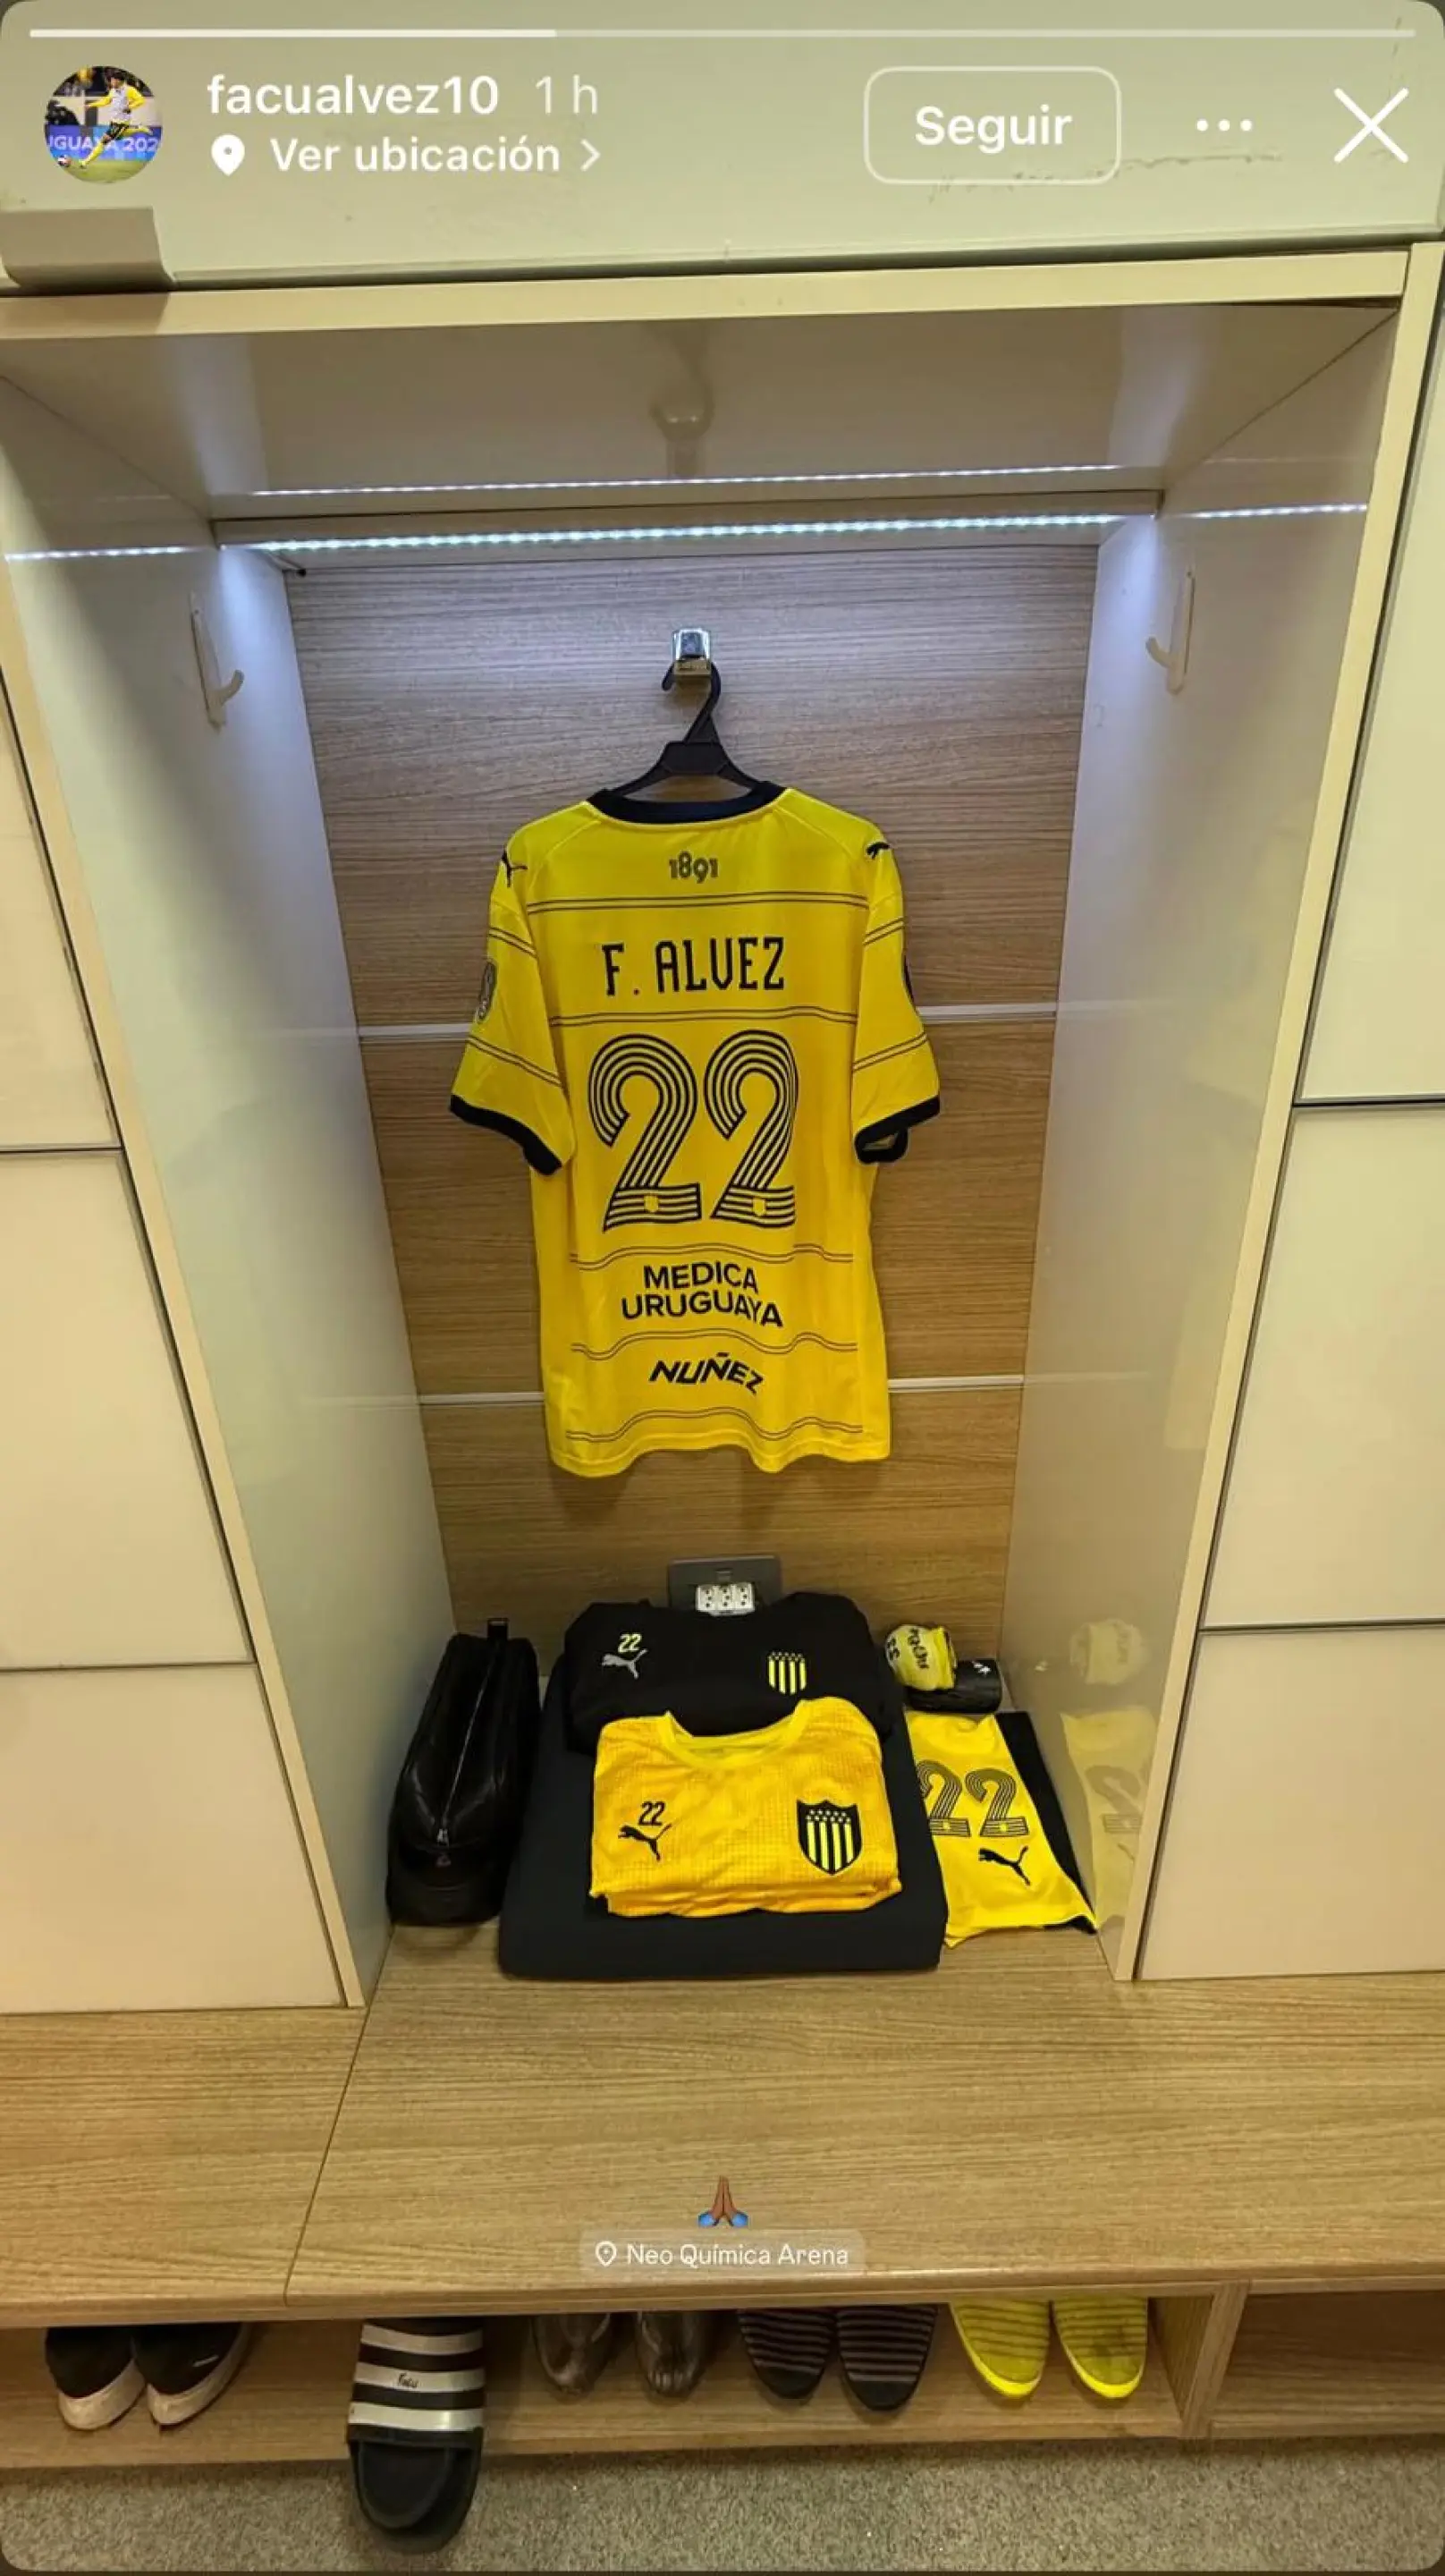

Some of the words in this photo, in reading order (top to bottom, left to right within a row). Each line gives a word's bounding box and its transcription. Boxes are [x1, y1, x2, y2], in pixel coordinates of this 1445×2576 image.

[669, 851, 719, 884] 1891
[655, 936, 784, 994] ALVEZ
[587, 1030, 799, 1233] 22
[643, 1261, 759, 1293] MEDICA
[621, 1289, 783, 1328] URUGUAYA
[648, 1352, 764, 1395] NUÑEZ
[618, 1632, 643, 1653] 22
[638, 1801, 666, 1826] 22
[917, 1758, 1030, 1838] 22
